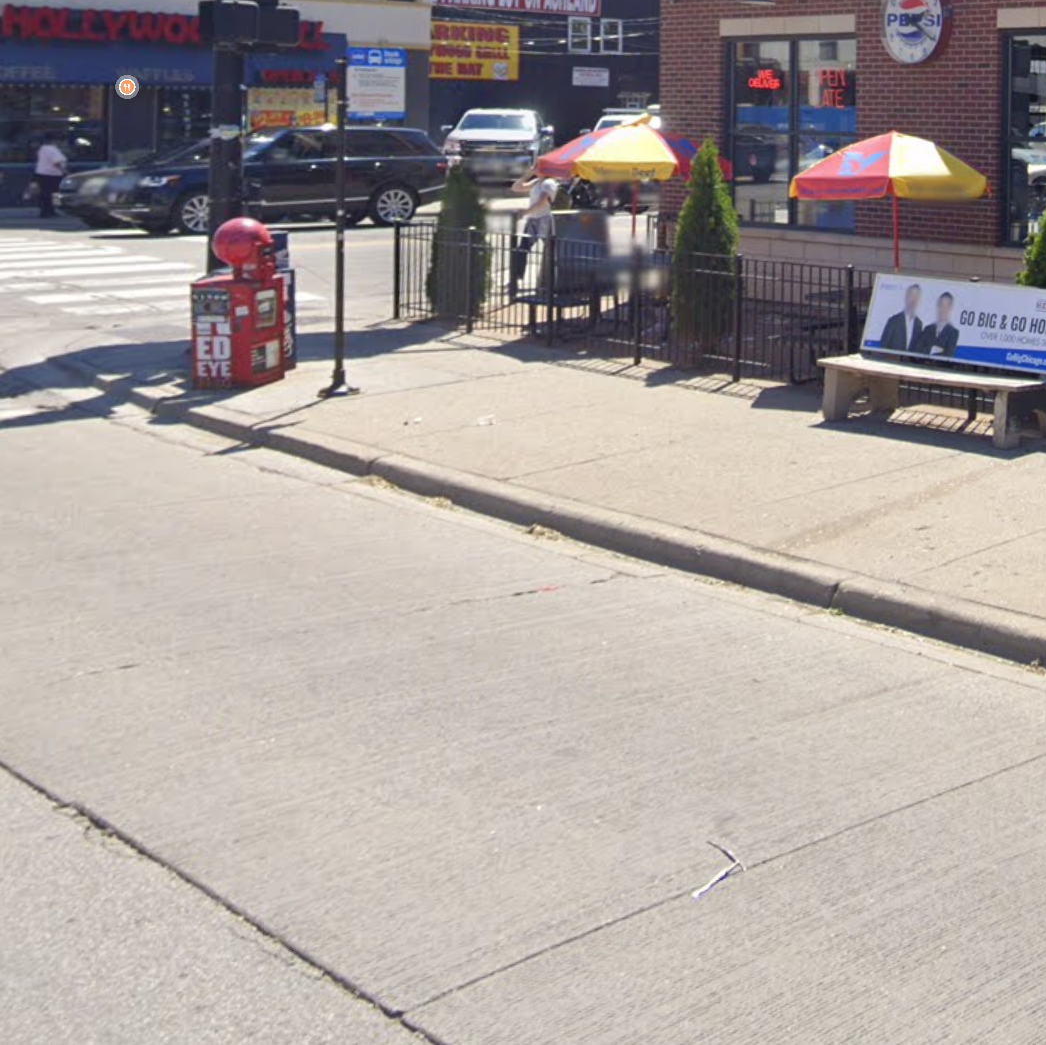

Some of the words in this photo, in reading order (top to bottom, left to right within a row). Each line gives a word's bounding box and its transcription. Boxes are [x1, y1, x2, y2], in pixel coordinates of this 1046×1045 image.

[887, 13, 941, 27] PESI
[960, 310, 975, 326] GO
[977, 312, 997, 329] BIG
[1000, 315, 1007, 330] &
[1011, 316, 1027, 332] GO
[980, 332, 998, 340] OVER
[1017, 336, 1040, 345] HOMES
[196, 361, 232, 377] EYE
